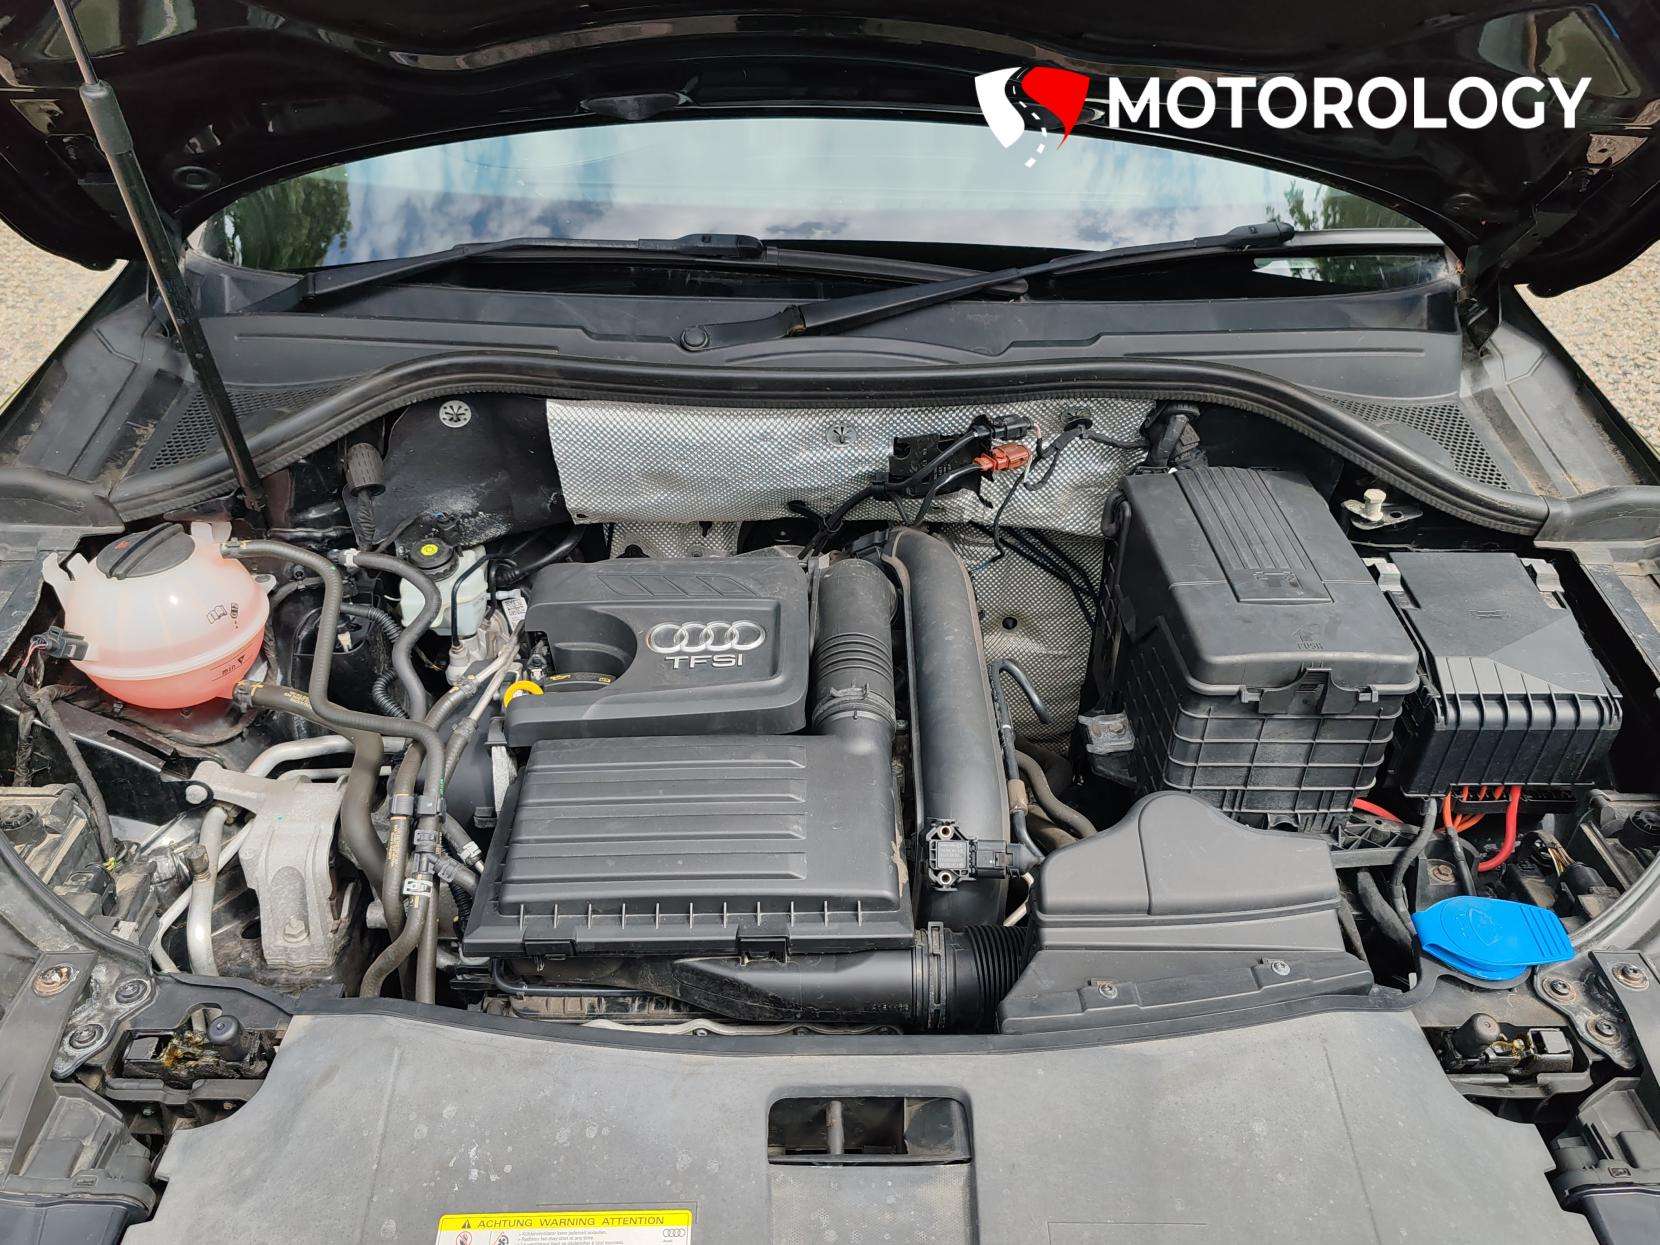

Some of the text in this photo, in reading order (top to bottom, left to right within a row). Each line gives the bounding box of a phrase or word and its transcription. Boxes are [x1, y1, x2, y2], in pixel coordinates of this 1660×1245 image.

[665, 653, 743, 669] TFSI
[477, 1216, 665, 1229] ACHTUNG WARNING ATTENTION
